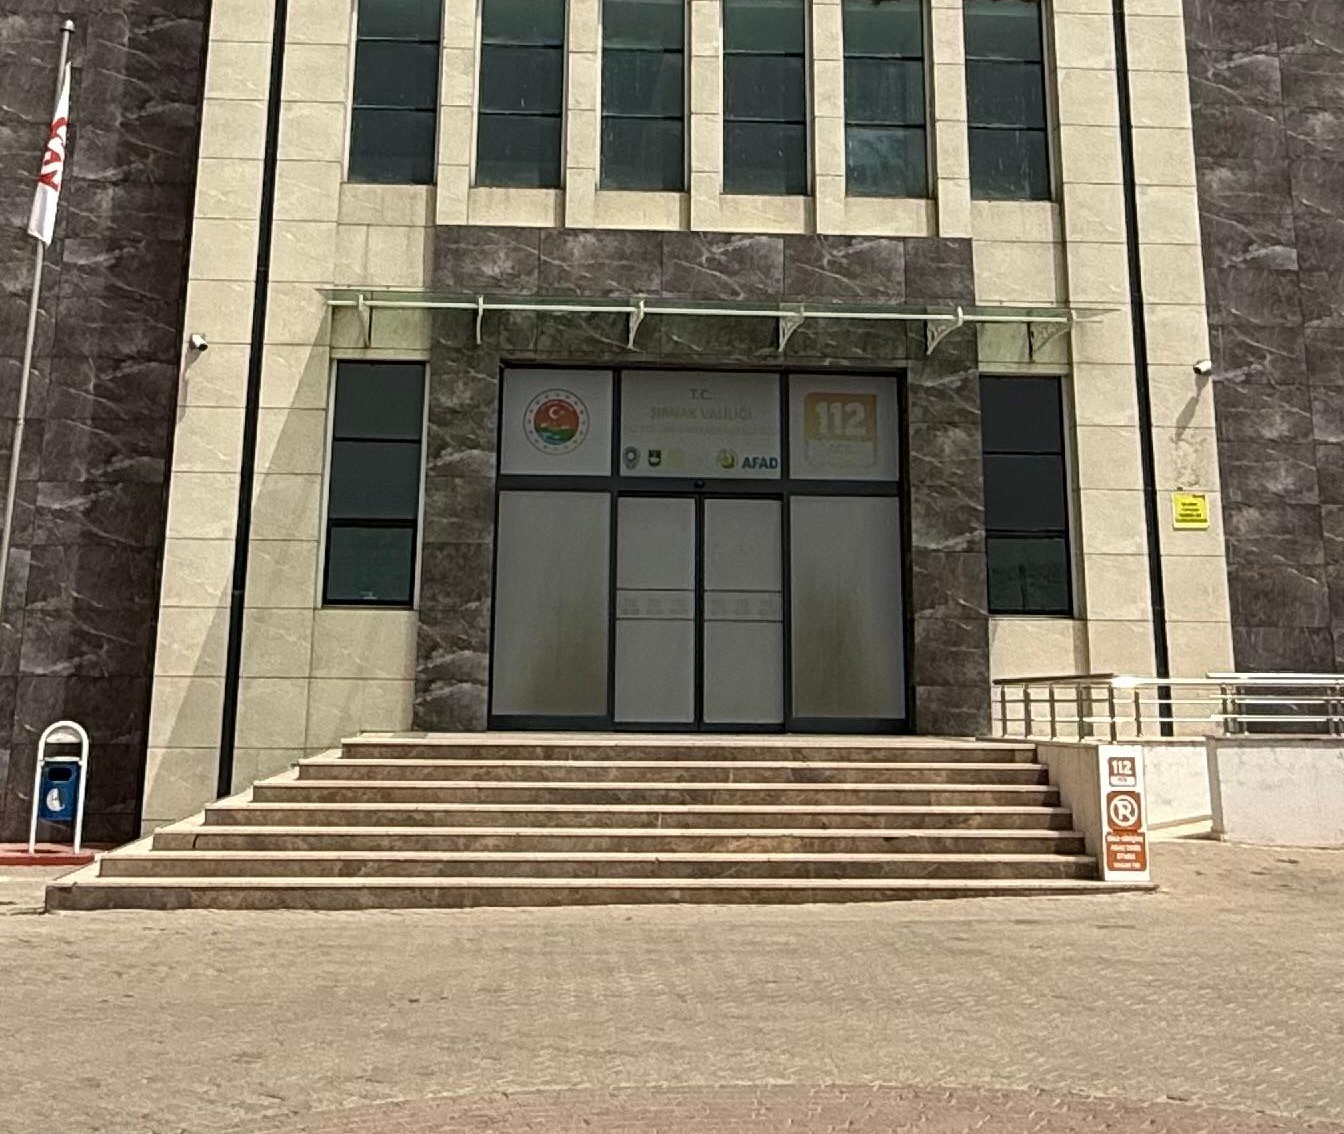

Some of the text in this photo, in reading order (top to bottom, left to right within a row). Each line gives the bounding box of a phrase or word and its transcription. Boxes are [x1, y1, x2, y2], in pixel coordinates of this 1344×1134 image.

[815, 401, 867, 436] 112
[741, 456, 779, 470] AFAD
[1111, 759, 1133, 775] 112
